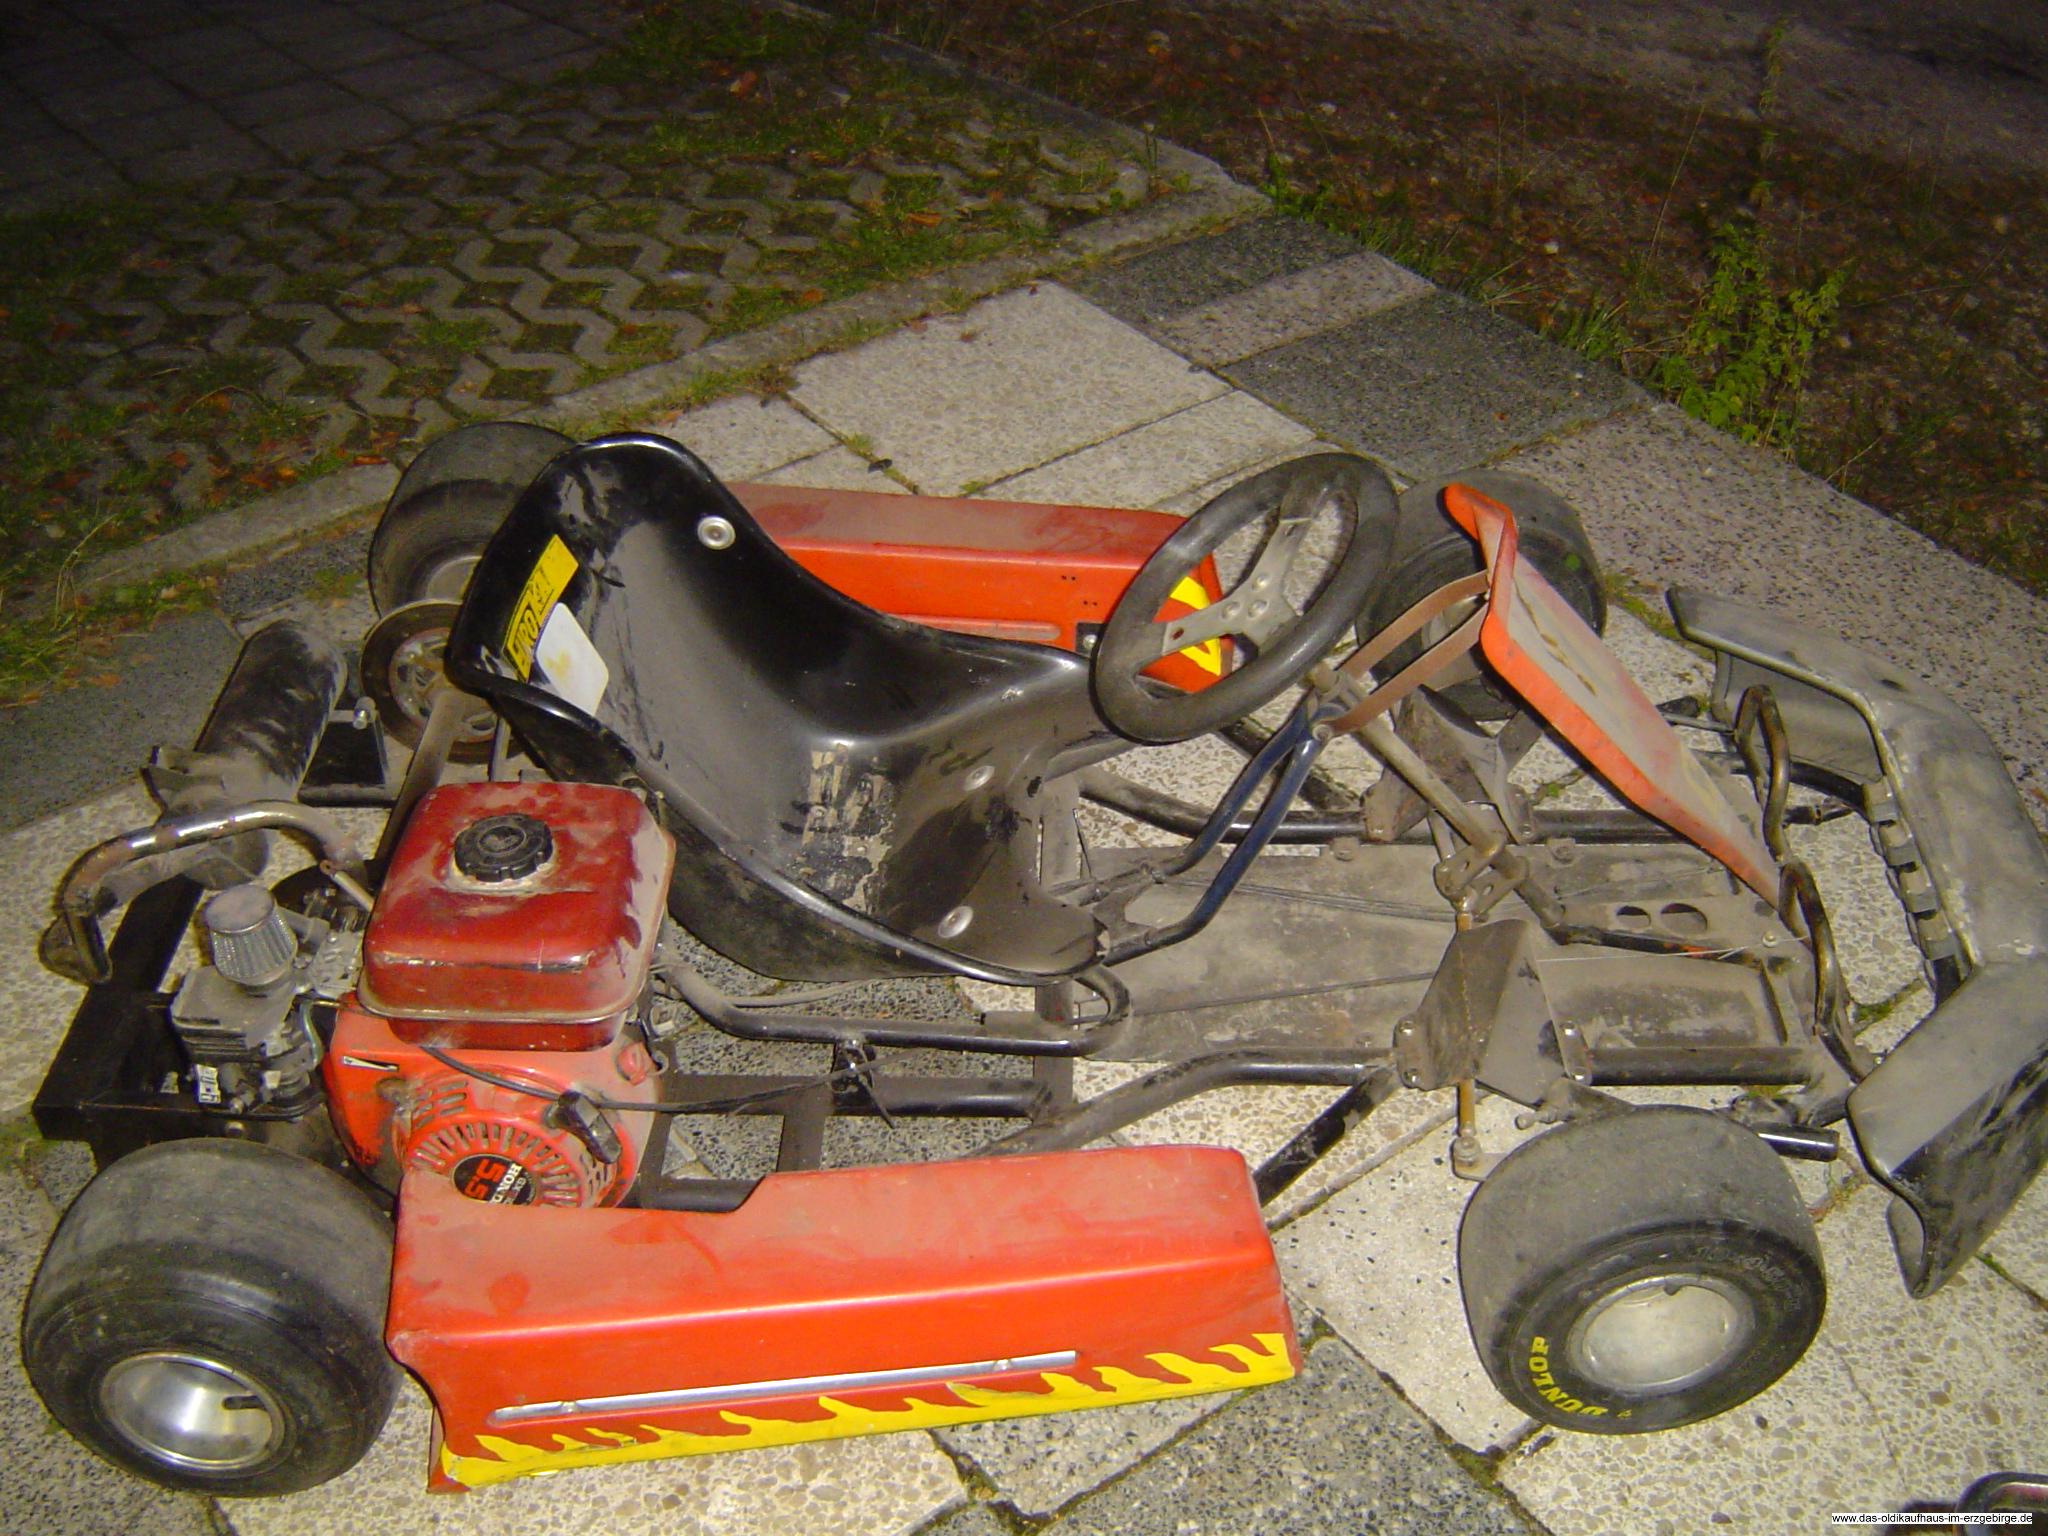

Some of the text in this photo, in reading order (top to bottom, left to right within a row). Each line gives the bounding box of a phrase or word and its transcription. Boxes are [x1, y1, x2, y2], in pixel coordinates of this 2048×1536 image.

[464, 1158, 508, 1200] 5.5
[489, 1163, 523, 1203] HOND
[1529, 1336, 1608, 1416] DUNLOP
